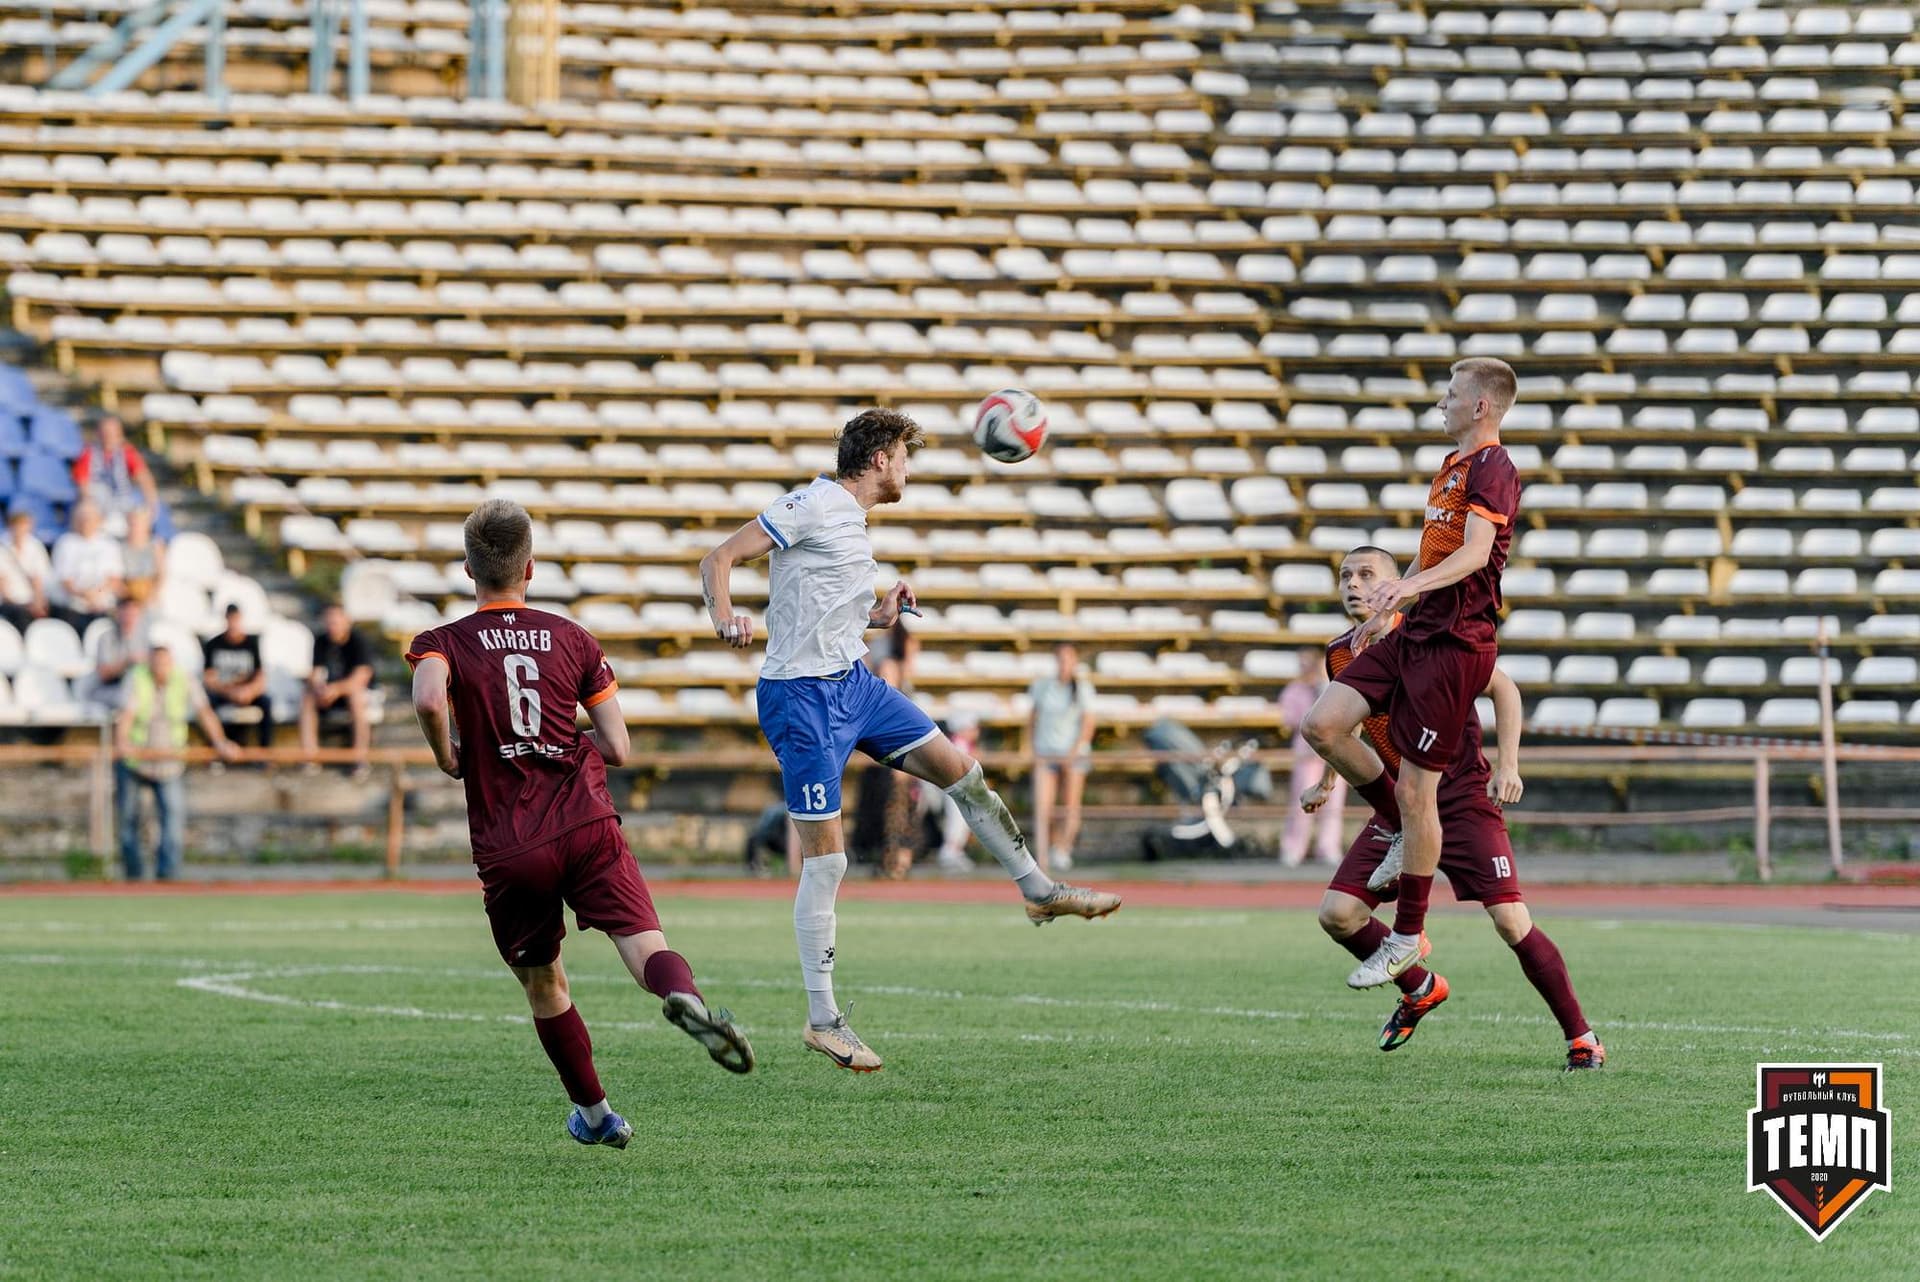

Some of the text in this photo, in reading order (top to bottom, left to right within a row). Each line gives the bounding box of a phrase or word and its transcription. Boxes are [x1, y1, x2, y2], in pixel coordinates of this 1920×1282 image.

[477, 628, 552, 652] КНЯЗЕВ
[503, 653, 542, 738] 6
[1416, 726, 1438, 753] 17
[801, 783, 828, 811] 13
[1491, 855, 1512, 879] 19
